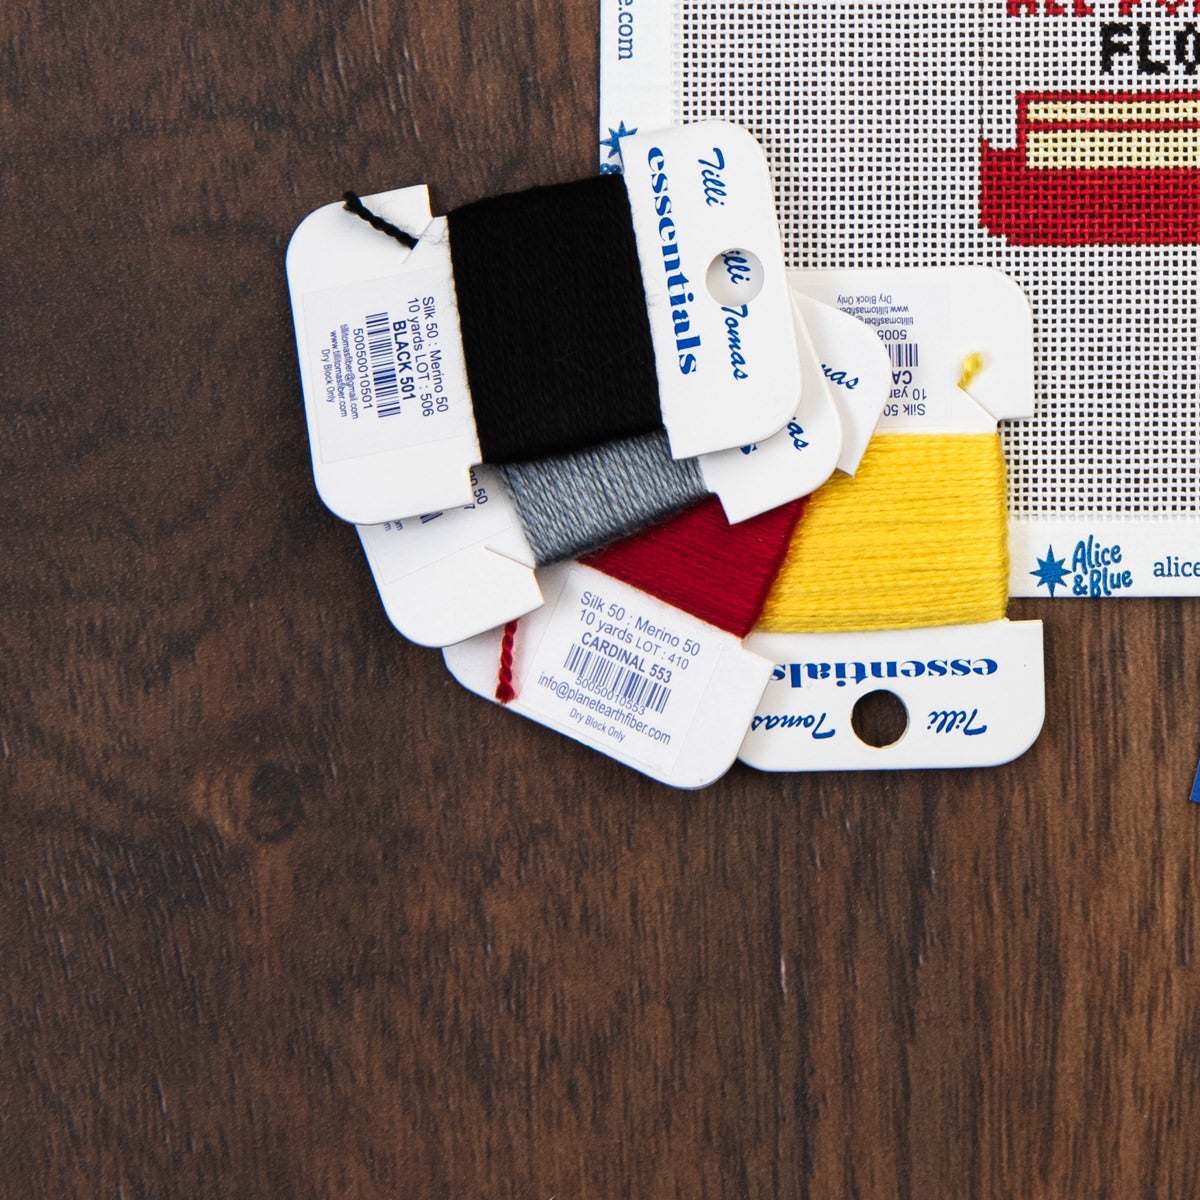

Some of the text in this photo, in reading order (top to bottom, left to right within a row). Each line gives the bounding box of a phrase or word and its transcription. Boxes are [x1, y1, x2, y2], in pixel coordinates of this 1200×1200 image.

[648, 146, 702, 376] essentials
[698, 146, 750, 381] Tilli Tomas
[352, 327, 373, 409] 50050010501
[392, 319, 417, 400] BLACK 501
[407, 297, 435, 417] 10 yards LOT 506
[422, 296, 449, 413] Silk 50 Merino 50
[903, 403, 926, 416] Silk
[1072, 534, 1122, 573] Alice
[580, 590, 701, 657] Silk 50 Merino 50
[580, 608, 690, 671] 10 yards LOT 410
[581, 631, 673, 684] CARDINAL 553
[771, 658, 998, 688] essentials
[537, 671, 672, 745] info@planetearthfiber.com
[569, 707, 626, 743] Dry Block Only
[751, 708, 988, 740] Tilli Tomas
